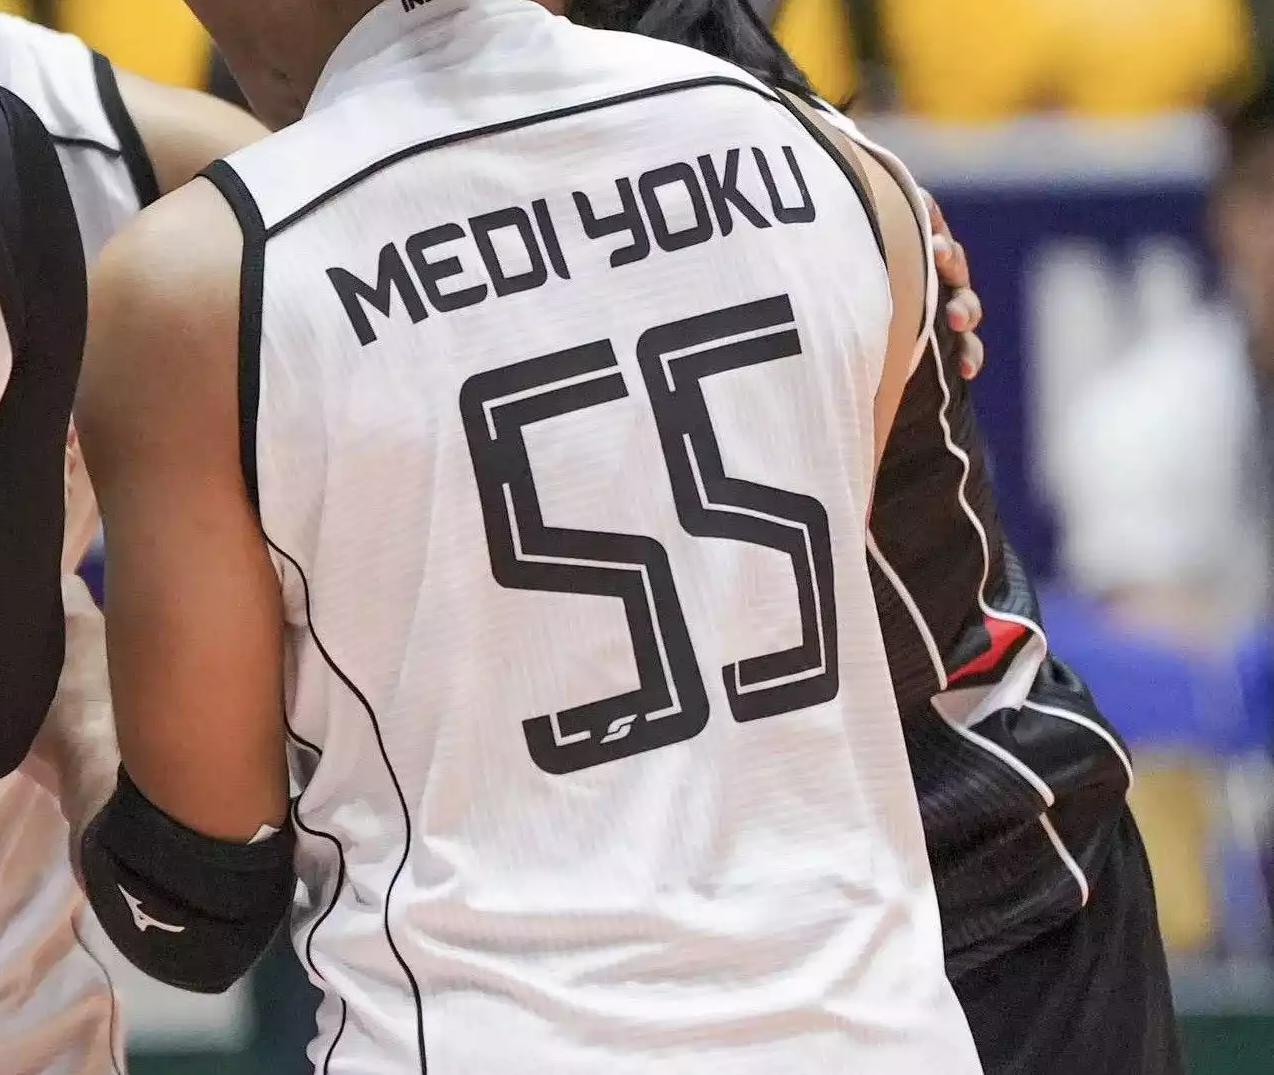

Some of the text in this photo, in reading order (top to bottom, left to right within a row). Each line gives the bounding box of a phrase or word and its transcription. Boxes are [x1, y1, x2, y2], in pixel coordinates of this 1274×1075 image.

[326, 146, 816, 347] MEDI YOKU
[459, 294, 839, 775] 55
